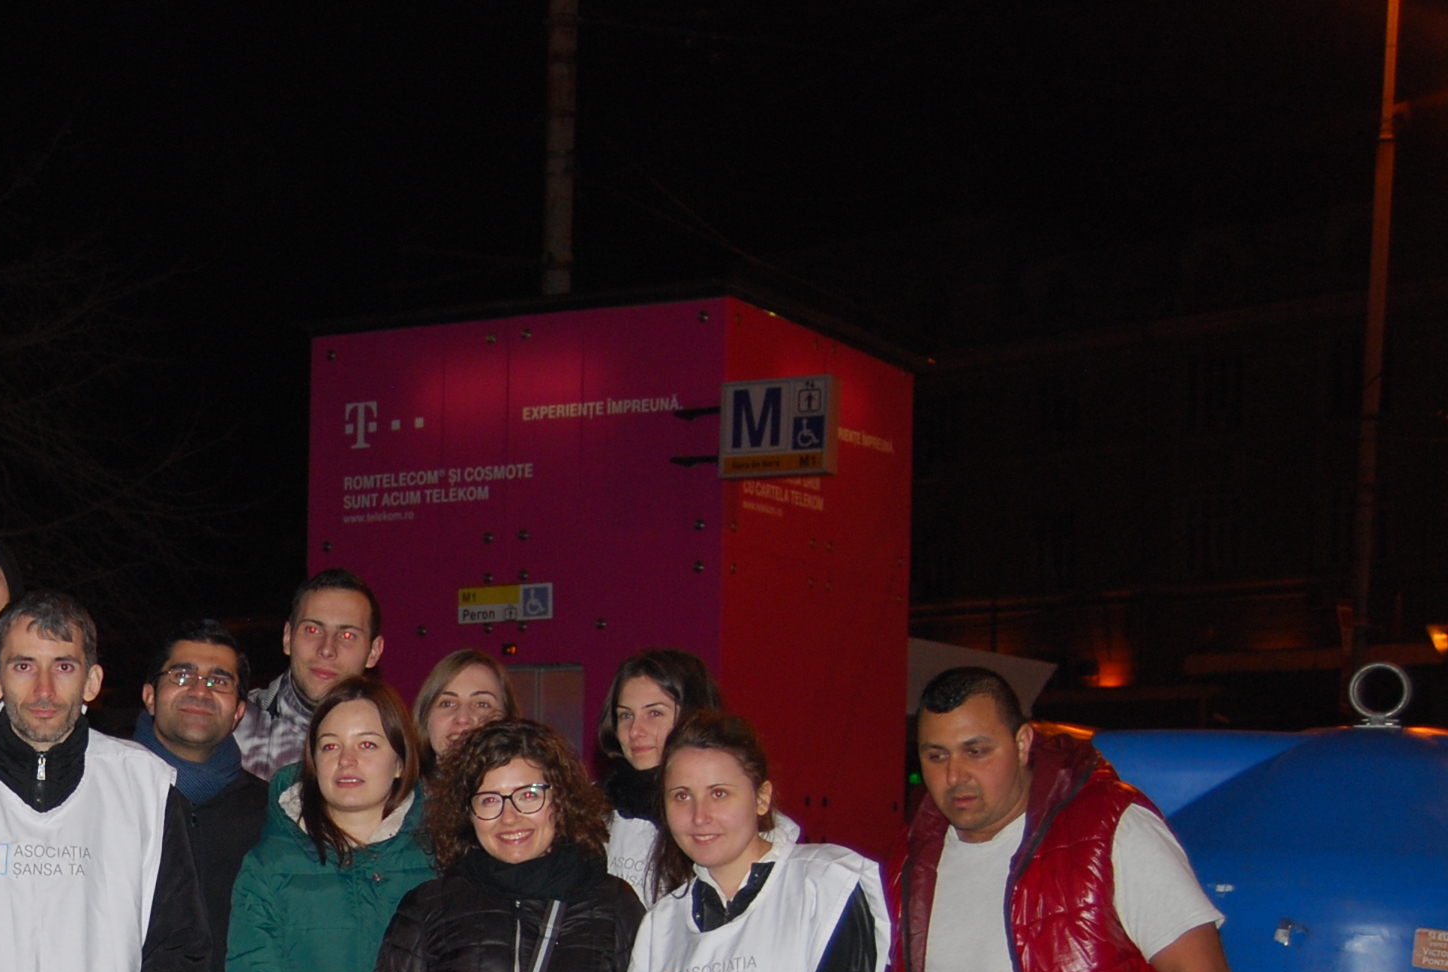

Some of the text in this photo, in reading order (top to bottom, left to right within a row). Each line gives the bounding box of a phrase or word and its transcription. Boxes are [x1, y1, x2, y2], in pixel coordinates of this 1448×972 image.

[523, 401, 604, 420] EXPERIENȚE
[732, 387, 782, 448] M
[799, 454, 816, 467] M1
[464, 463, 533, 482] COSMOTE
[344, 486, 490, 509] SUNT ACUM TELEKOM
[462, 609, 496, 621] Peron
[13, 844, 92, 861] ASOCIAȚIA
[13, 862, 86, 879] ȘANSA TA
